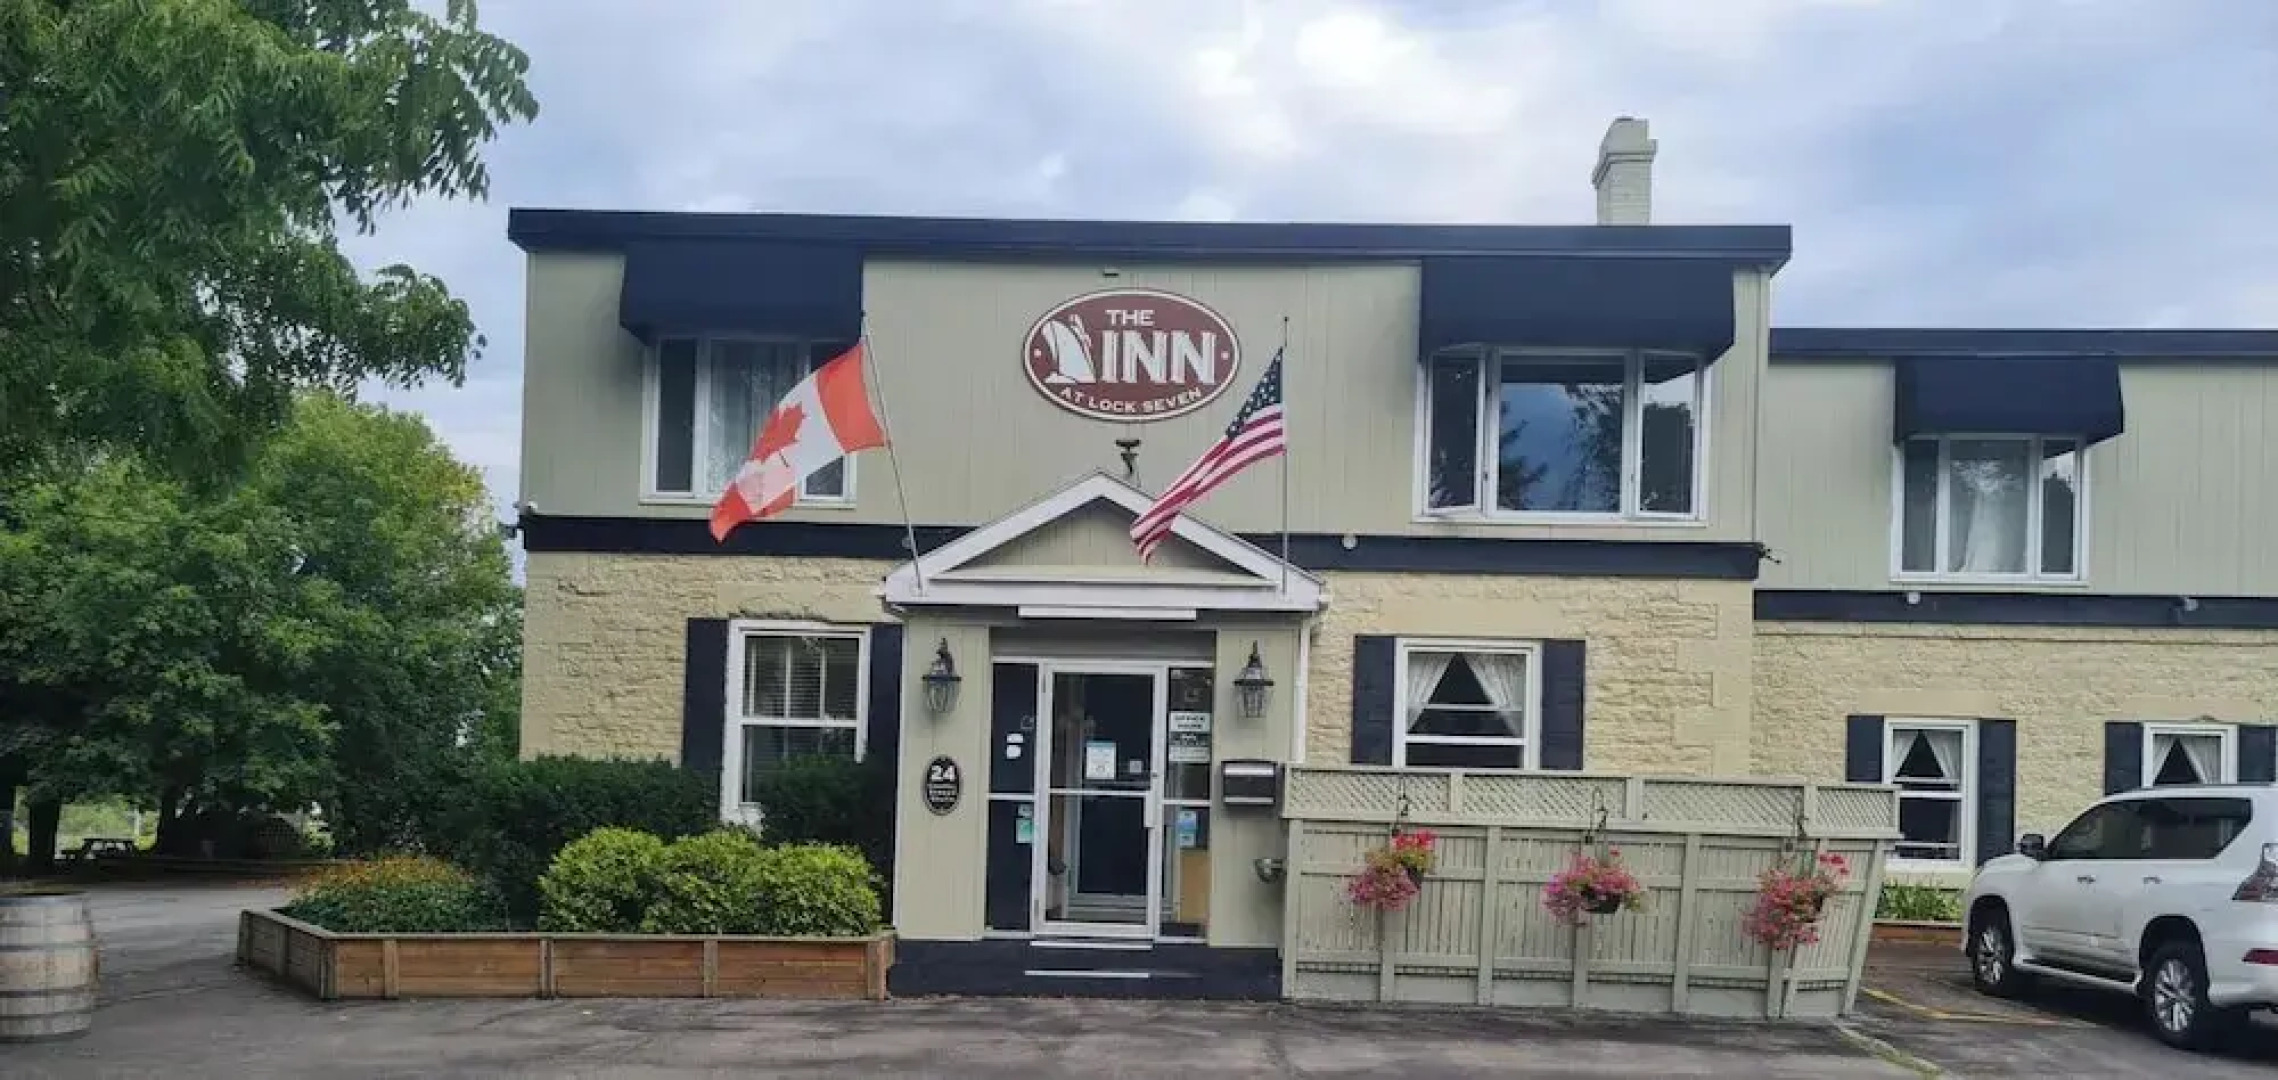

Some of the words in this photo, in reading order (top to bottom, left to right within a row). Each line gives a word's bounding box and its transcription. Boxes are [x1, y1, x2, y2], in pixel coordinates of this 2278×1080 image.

[1105, 309, 1155, 326] THE
[1101, 330, 1217, 384] INN
[1060, 386, 1085, 404] AT
[1088, 396, 1137, 413] LOCK
[1142, 386, 1202, 413] SEVEN
[931, 765, 955, 781] 24
